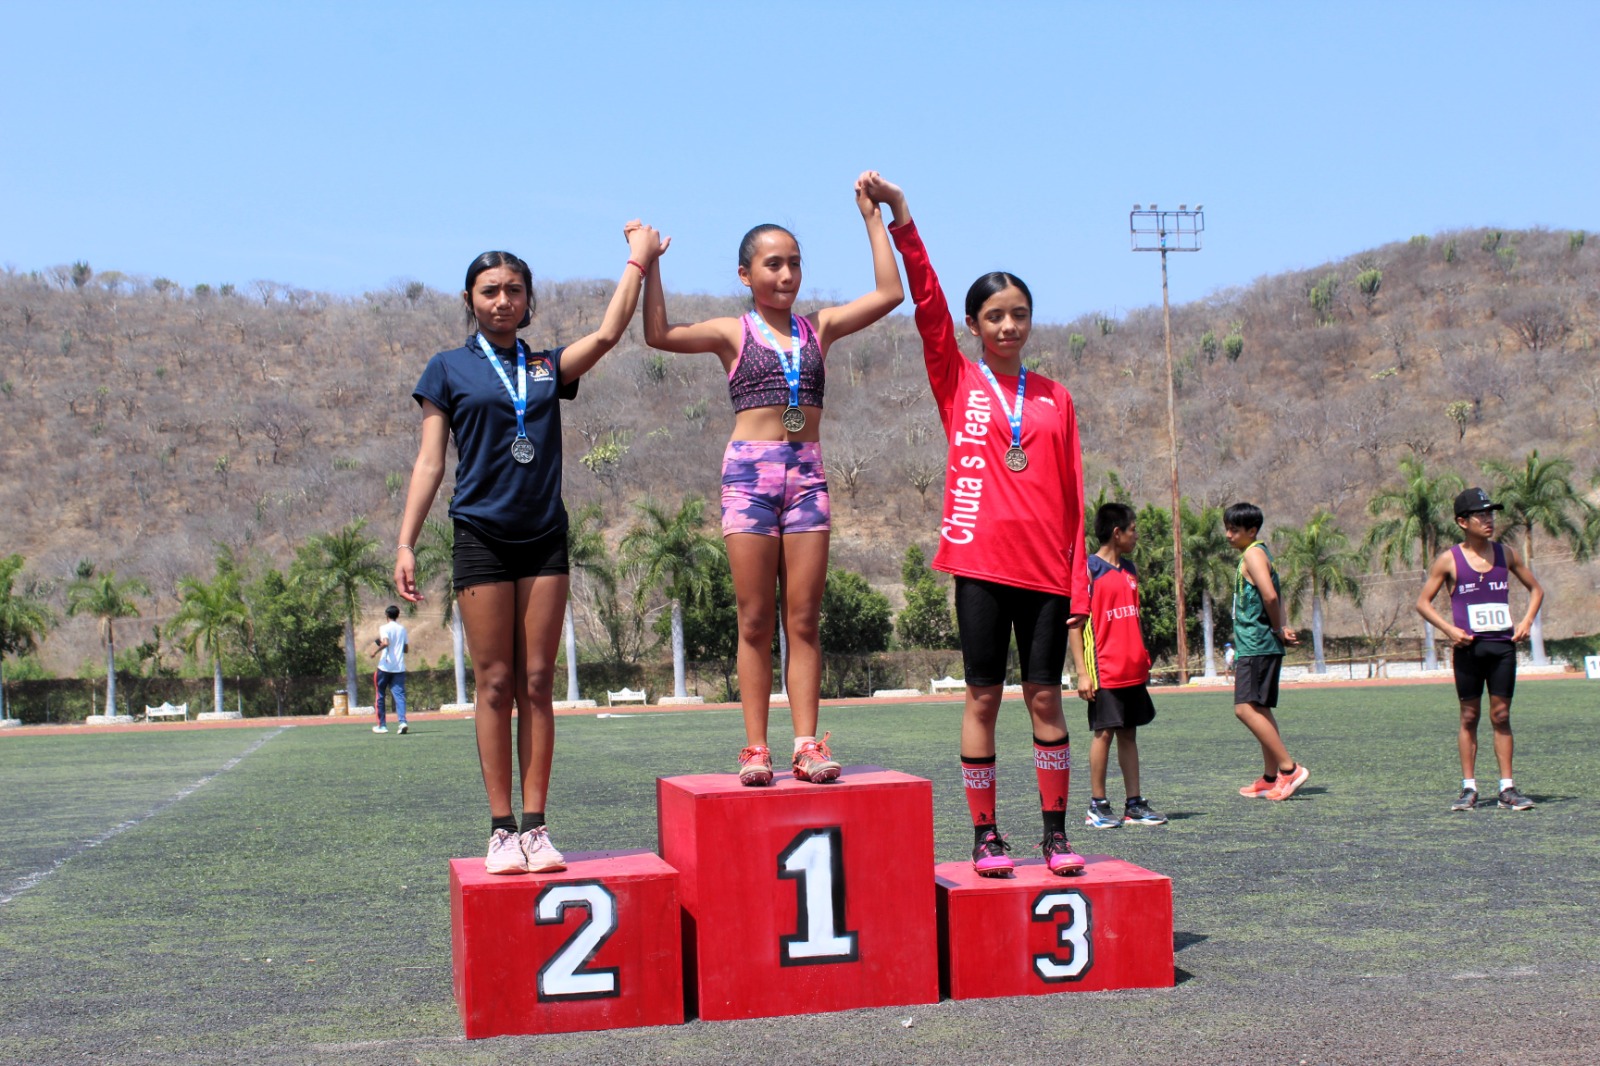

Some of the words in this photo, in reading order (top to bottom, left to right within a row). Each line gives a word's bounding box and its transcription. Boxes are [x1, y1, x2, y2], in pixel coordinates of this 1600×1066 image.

[954, 389, 992, 447] Team
[1475, 609, 1506, 626] 510
[535, 879, 620, 1002] 2
[776, 826, 859, 968] 1
[1031, 888, 1094, 984] 3
